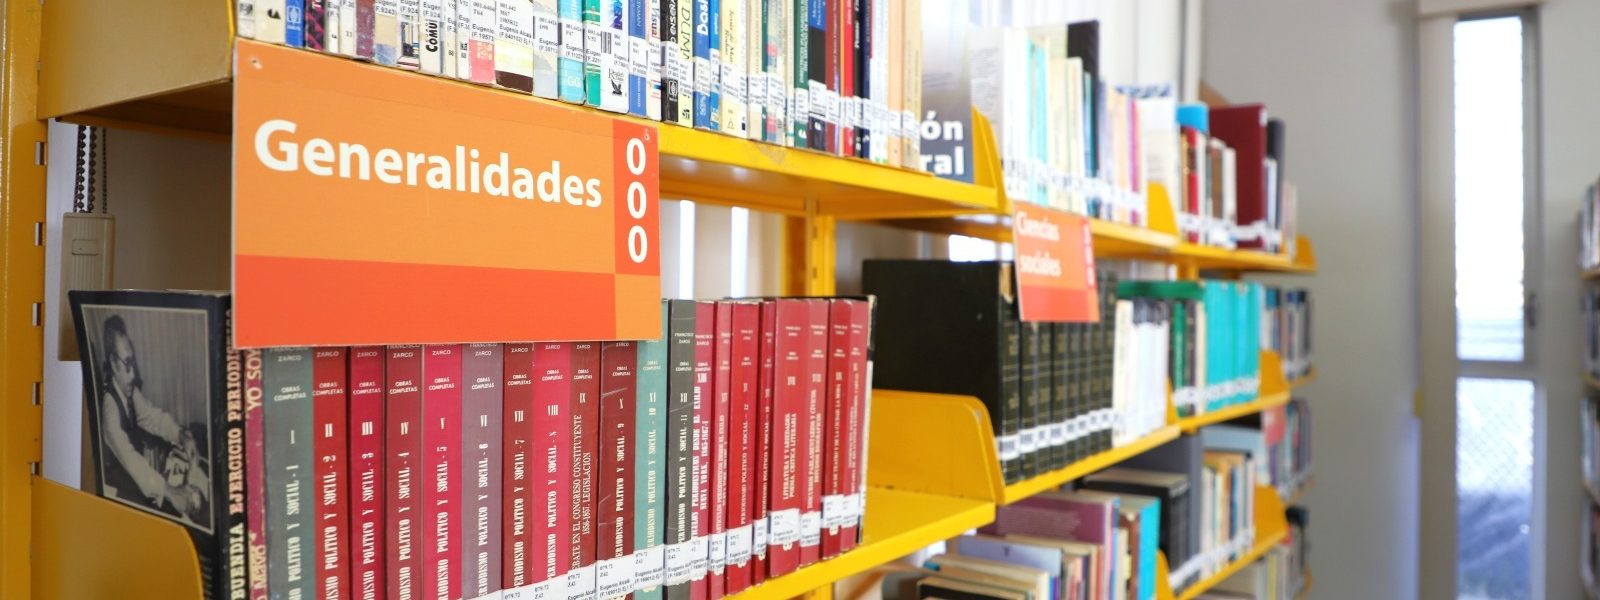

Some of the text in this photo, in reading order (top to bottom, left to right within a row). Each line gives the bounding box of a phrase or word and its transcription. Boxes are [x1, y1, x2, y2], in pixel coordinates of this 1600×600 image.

[254, 119, 602, 208] Generalidades
[246, 387, 262, 411] YO
[274, 392, 307, 401] COMPLETAS
[281, 385, 300, 393] OBRAS
[312, 388, 344, 396] COMPLETAS
[429, 383, 455, 391] COMPLETAS
[471, 382, 494, 390] COMPLETAS
[693, 386, 701, 410] EXILIO
[693, 414, 700, 424] EL
[617, 436, 625, 462] SOCIAL
[648, 429, 656, 455] SOCIAL
[679, 427, 687, 452] SOCIAL
[692, 428, 700, 451] DESDE
[228, 428, 244, 515] EJERCICIO
[322, 454, 336, 463] 2
[478, 458, 488, 488] SOCIAL
[514, 451, 524, 480] SOCIAL
[547, 445, 557, 473] SOCIAL
[323, 472, 337, 506] SOCIAL
[361, 468, 374, 501] SOCIAL
[398, 467, 410, 499] SOCIAL
[437, 461, 448, 493] SOCIAL
[573, 414, 582, 544] EN EL CONGRESO CONSTITUYENTE
[582, 452, 591, 502] LEGISLACION
[647, 470, 656, 503] POLITICO
[679, 466, 687, 498] POLITICO
[286, 480, 300, 516] SOCIAL
[547, 490, 557, 528] POLITICO
[615, 477, 624, 511] POLITICO
[286, 522, 300, 531] Y
[437, 511, 448, 553] POLITICO
[478, 506, 488, 546] POLITICO
[514, 498, 524, 536] POLITICO
[324, 526, 338, 570] POLITICO
[362, 521, 375, 564] POLITICO
[398, 519, 410, 561] POLITICO
[229, 522, 245, 600] BUENDIA
[287, 536, 301, 582] POLITICO
